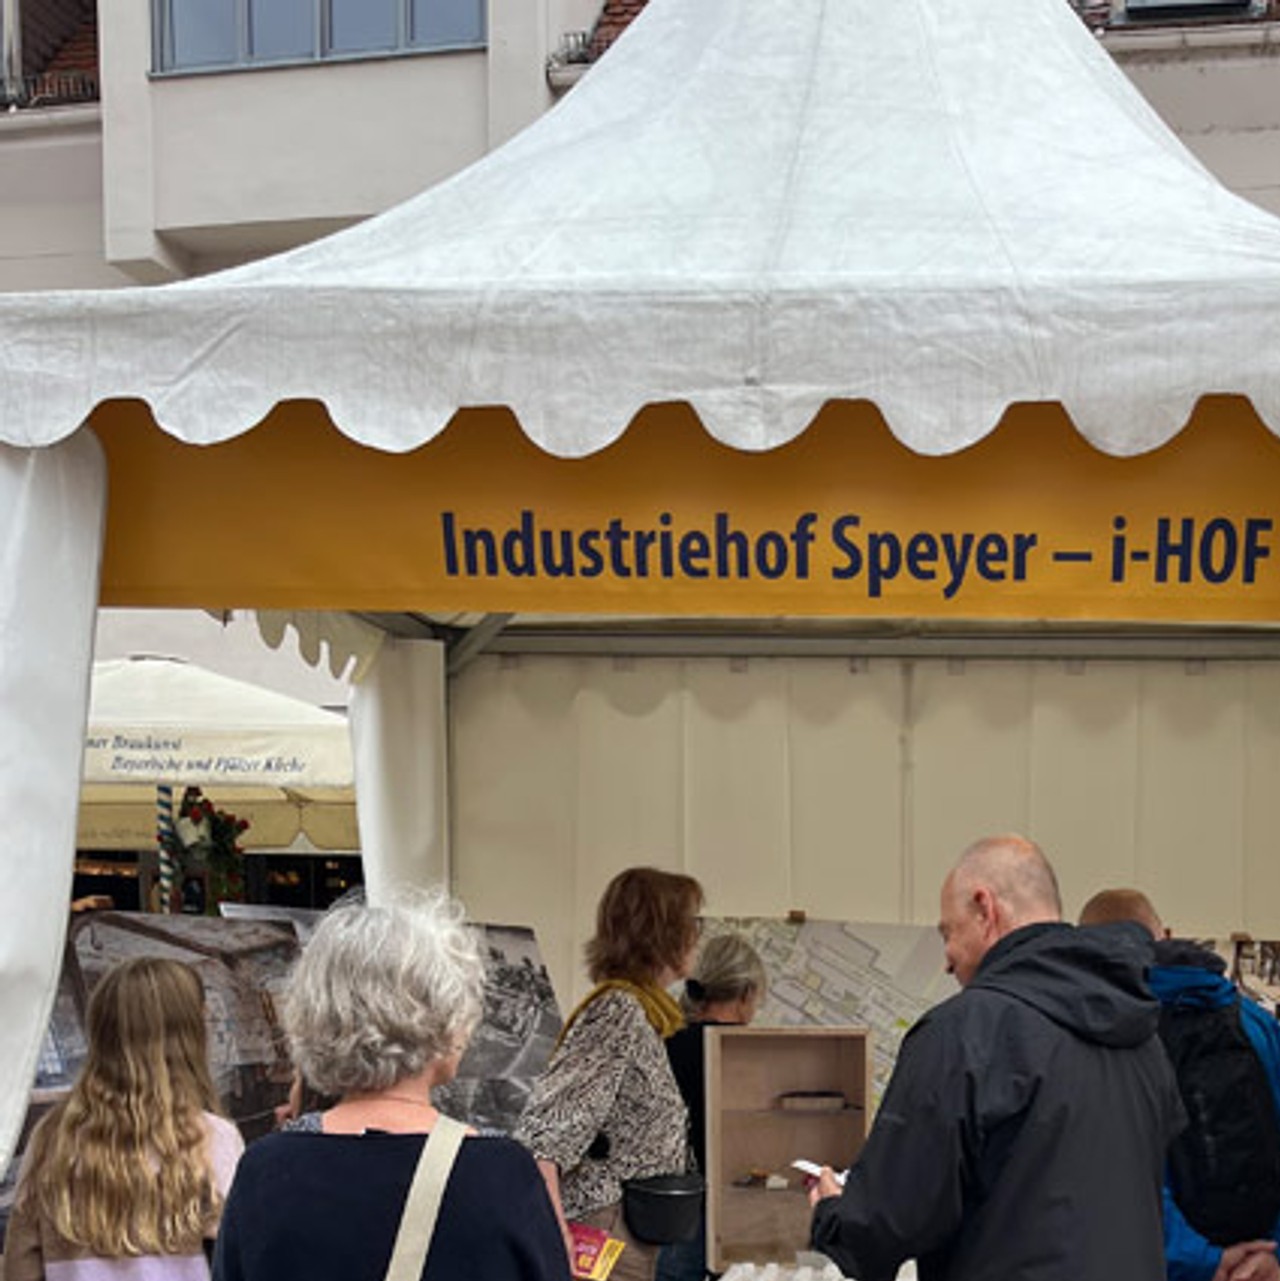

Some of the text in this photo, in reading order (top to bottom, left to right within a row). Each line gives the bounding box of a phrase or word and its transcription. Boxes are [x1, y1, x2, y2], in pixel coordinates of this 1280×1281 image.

[441, 510, 819, 580] Industriehof
[831, 514, 1037, 600] Speyer
[1110, 515, 1273, 584] i-HOF
[186, 757, 213, 772] und
